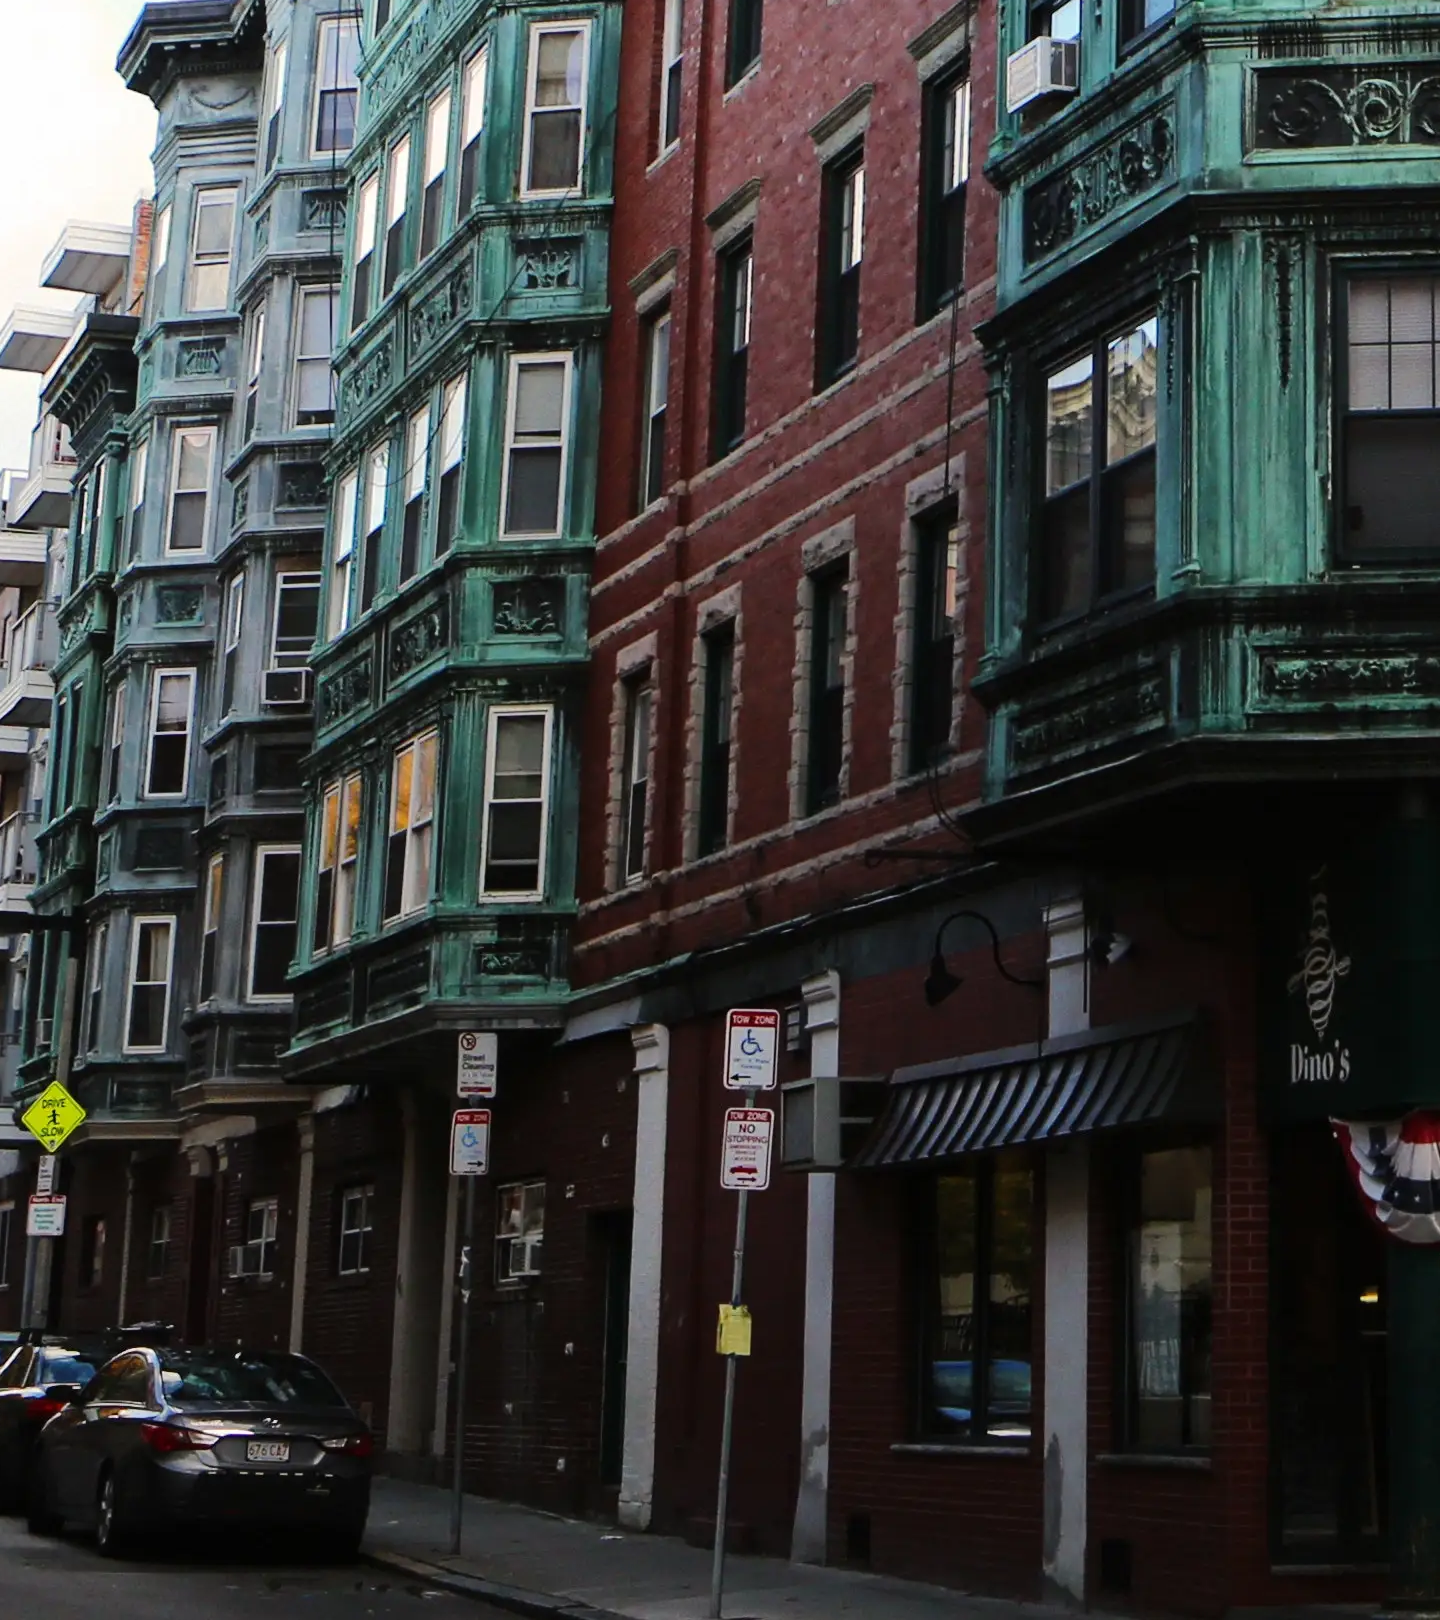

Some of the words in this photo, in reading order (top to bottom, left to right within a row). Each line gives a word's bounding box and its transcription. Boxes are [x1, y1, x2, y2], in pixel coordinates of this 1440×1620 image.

[732, 1015, 750, 1024] TOW
[754, 1015, 776, 1025] ZONE
[1290, 1039, 1350, 1084] Dino's
[42, 1098, 66, 1109] DRIVE
[730, 1111, 745, 1120] TOW
[746, 1112, 768, 1121] ZONE
[40, 1127, 65, 1137] SLOW
[739, 1124, 756, 1134] NO
[726, 1135, 768, 1144] STOPPING
